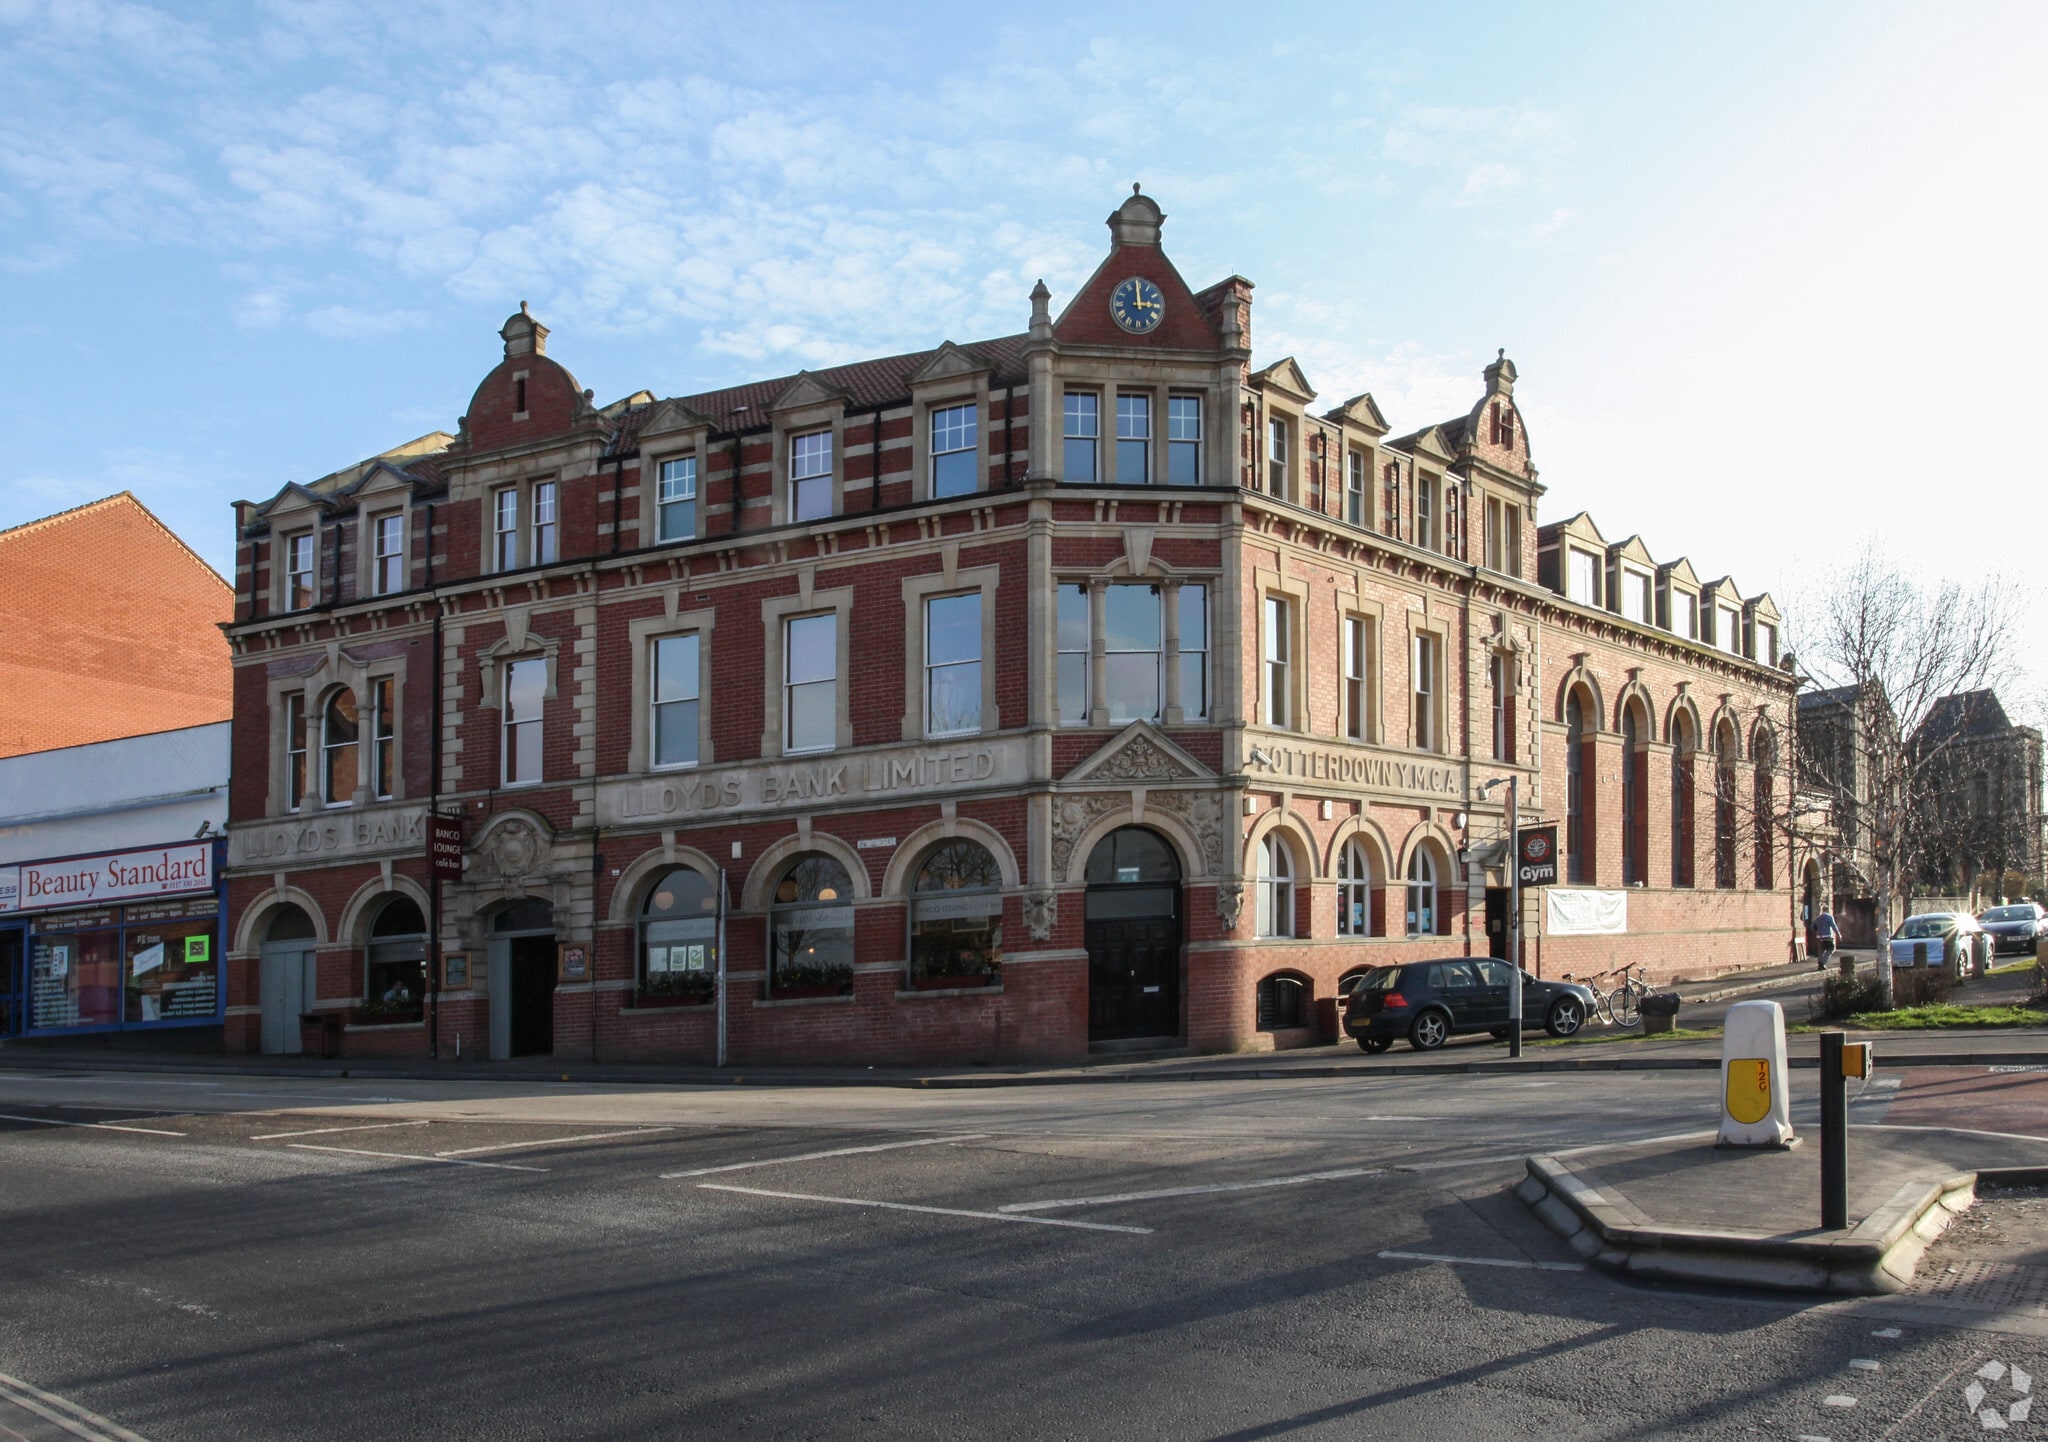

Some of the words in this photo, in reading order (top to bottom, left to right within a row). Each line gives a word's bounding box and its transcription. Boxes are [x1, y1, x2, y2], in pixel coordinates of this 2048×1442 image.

[622, 780, 743, 818] LLOYDS
[760, 764, 848, 801] BANK
[863, 750, 996, 794] LIMITED
[244, 824, 339, 860] LLOYDS
[355, 815, 425, 847] BANK
[435, 828, 460, 840] BANCO
[433, 842, 461, 855] LOUNGE
[449, 859, 460, 869] bar
[28, 870, 100, 898] Beauty
[107, 847, 206, 888] Standard
[1520, 866, 1554, 882] Gym
